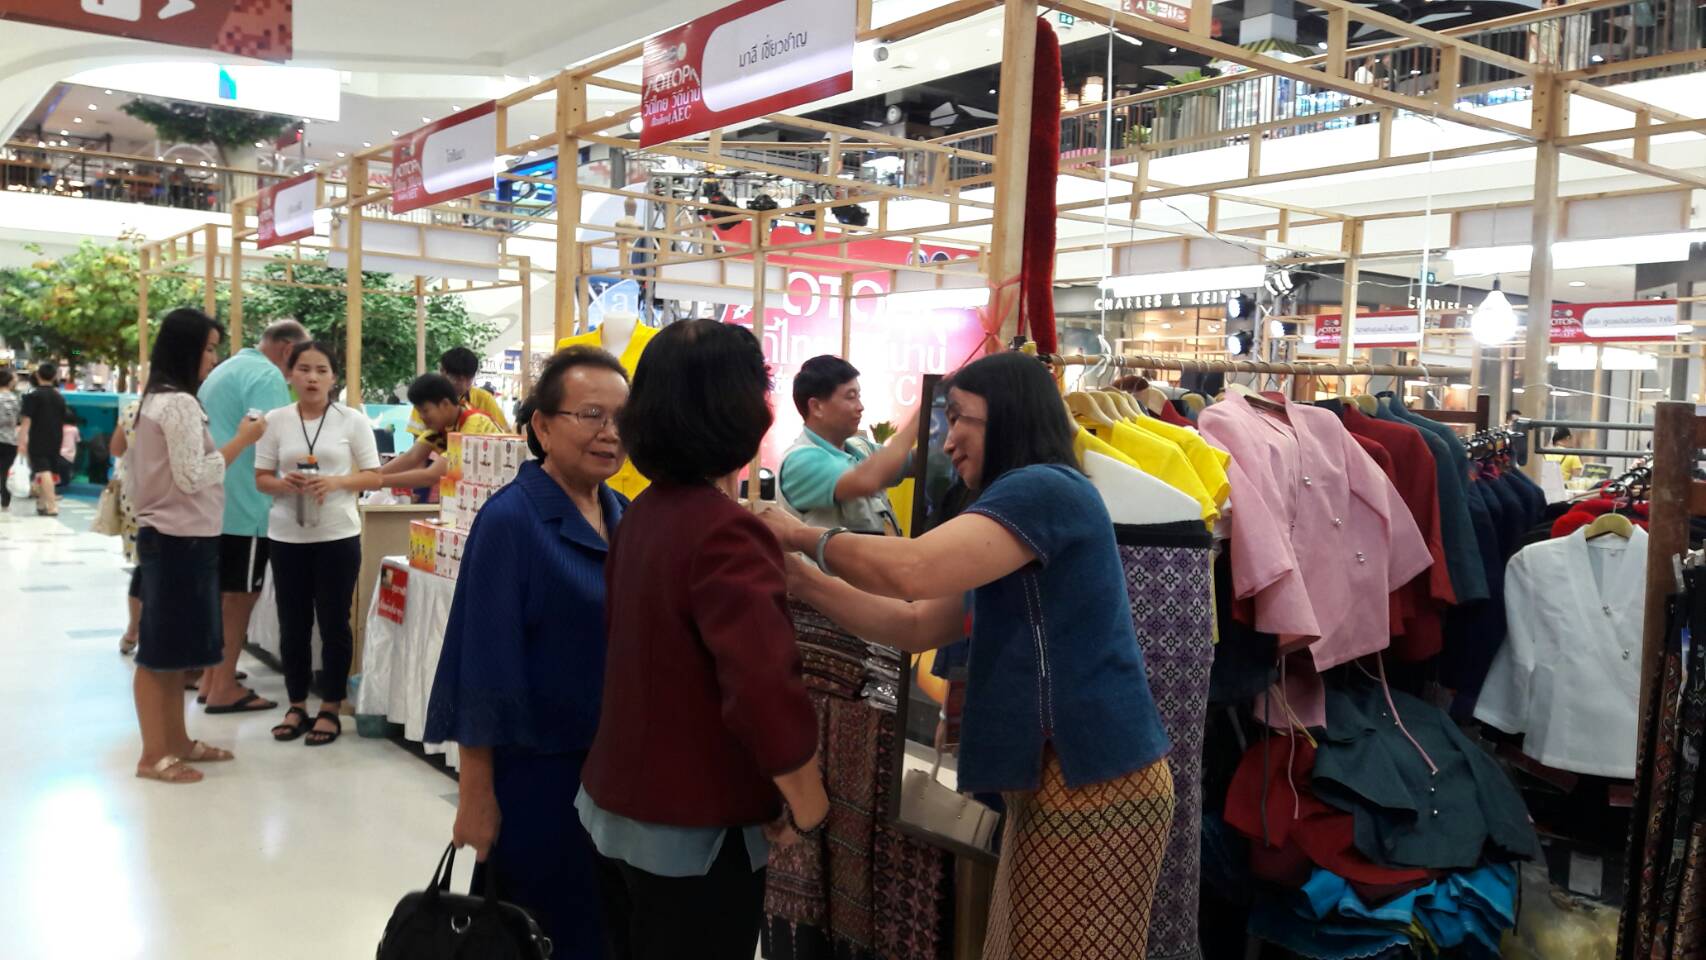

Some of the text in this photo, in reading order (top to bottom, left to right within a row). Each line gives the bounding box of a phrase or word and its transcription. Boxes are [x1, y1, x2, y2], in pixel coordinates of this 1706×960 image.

[739, 31, 808, 68] มาลี เชี่ยวชาญ
[654, 65, 690, 93] OTOP
[671, 104, 692, 122] AEC
[782, 271, 886, 323] OTO
[1094, 294, 1162, 311] CHARLES
[1171, 293, 1181, 306] &
